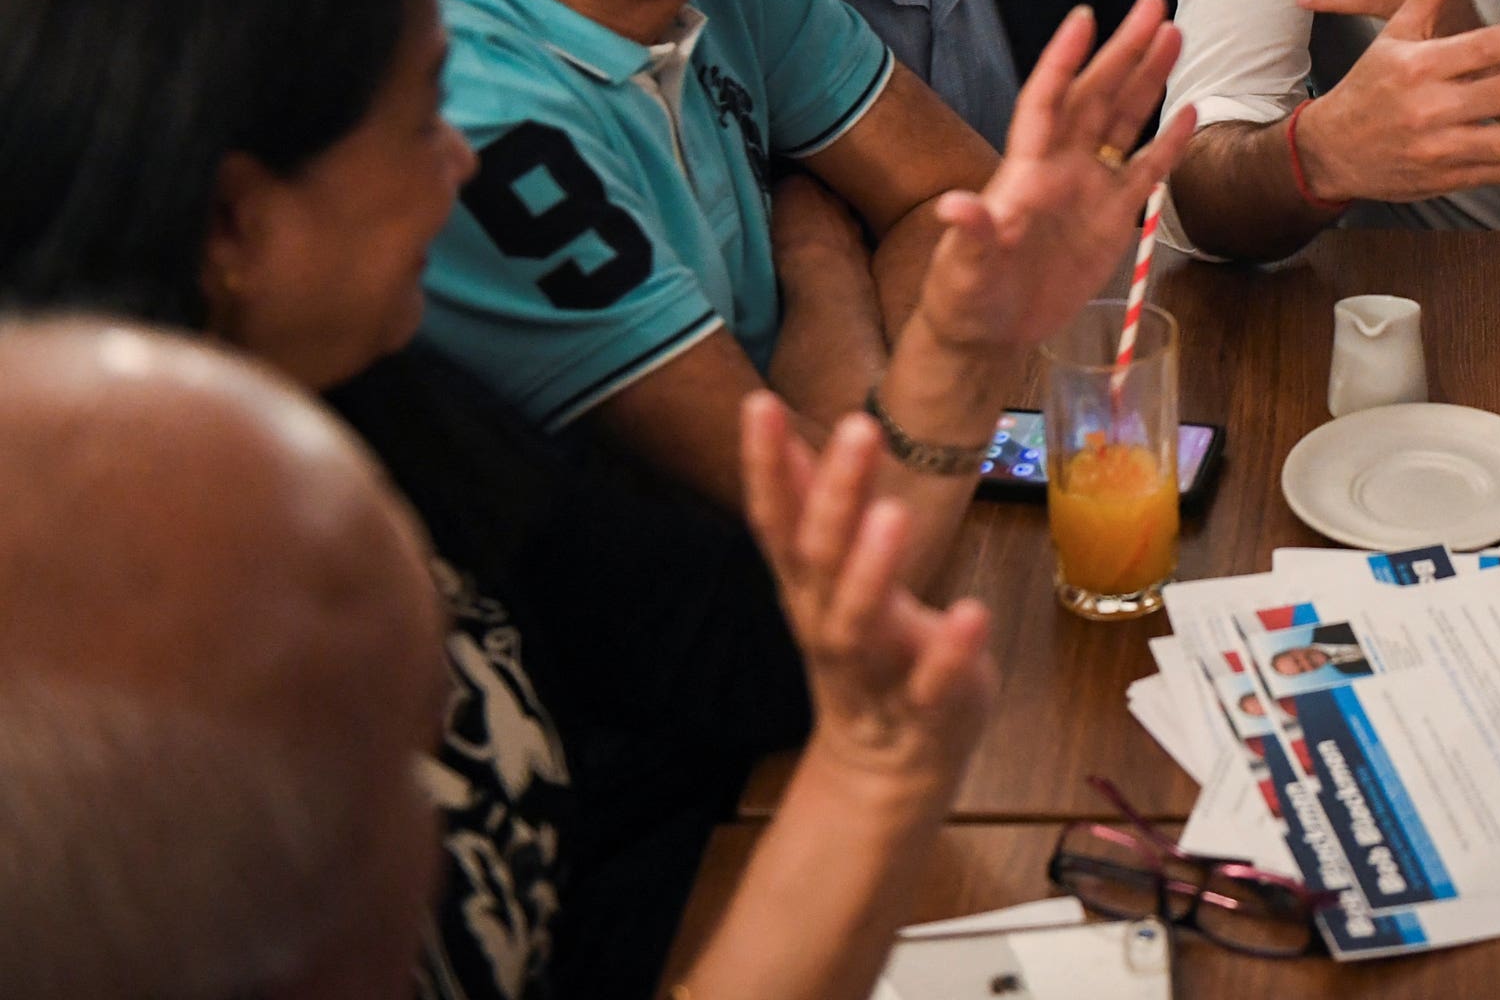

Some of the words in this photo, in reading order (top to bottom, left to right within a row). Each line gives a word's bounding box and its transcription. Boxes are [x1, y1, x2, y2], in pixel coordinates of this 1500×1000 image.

[459, 118, 655, 311] 9
[1316, 739, 1384, 847] Blackman
[1366, 846, 1408, 895] Bob
